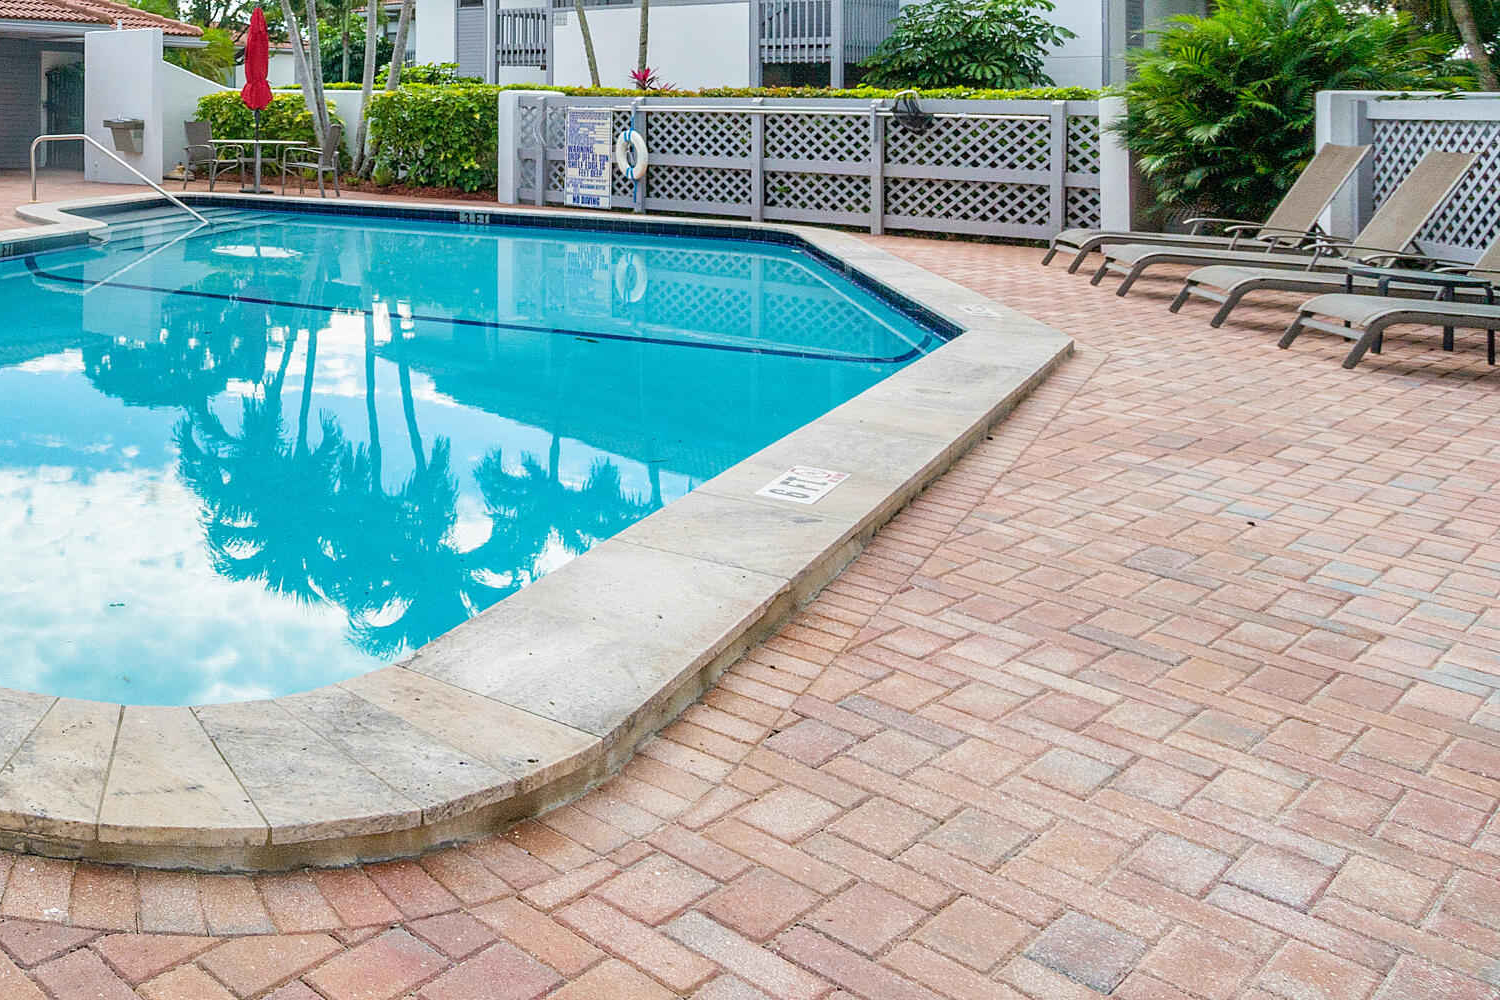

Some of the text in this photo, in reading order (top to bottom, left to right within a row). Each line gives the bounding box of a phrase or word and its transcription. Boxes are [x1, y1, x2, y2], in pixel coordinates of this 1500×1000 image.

[568, 145, 595, 154] WARNING:
[568, 153, 580, 161] DROP
[599, 154, 609, 162] SUN
[568, 161, 606, 170] SHELF EDGE IS
[578, 168, 589, 177] FEET
[572, 195, 601, 206] NO DIVING
[464, 212, 489, 223] 3 FT
[768, 488, 810, 499] 6
